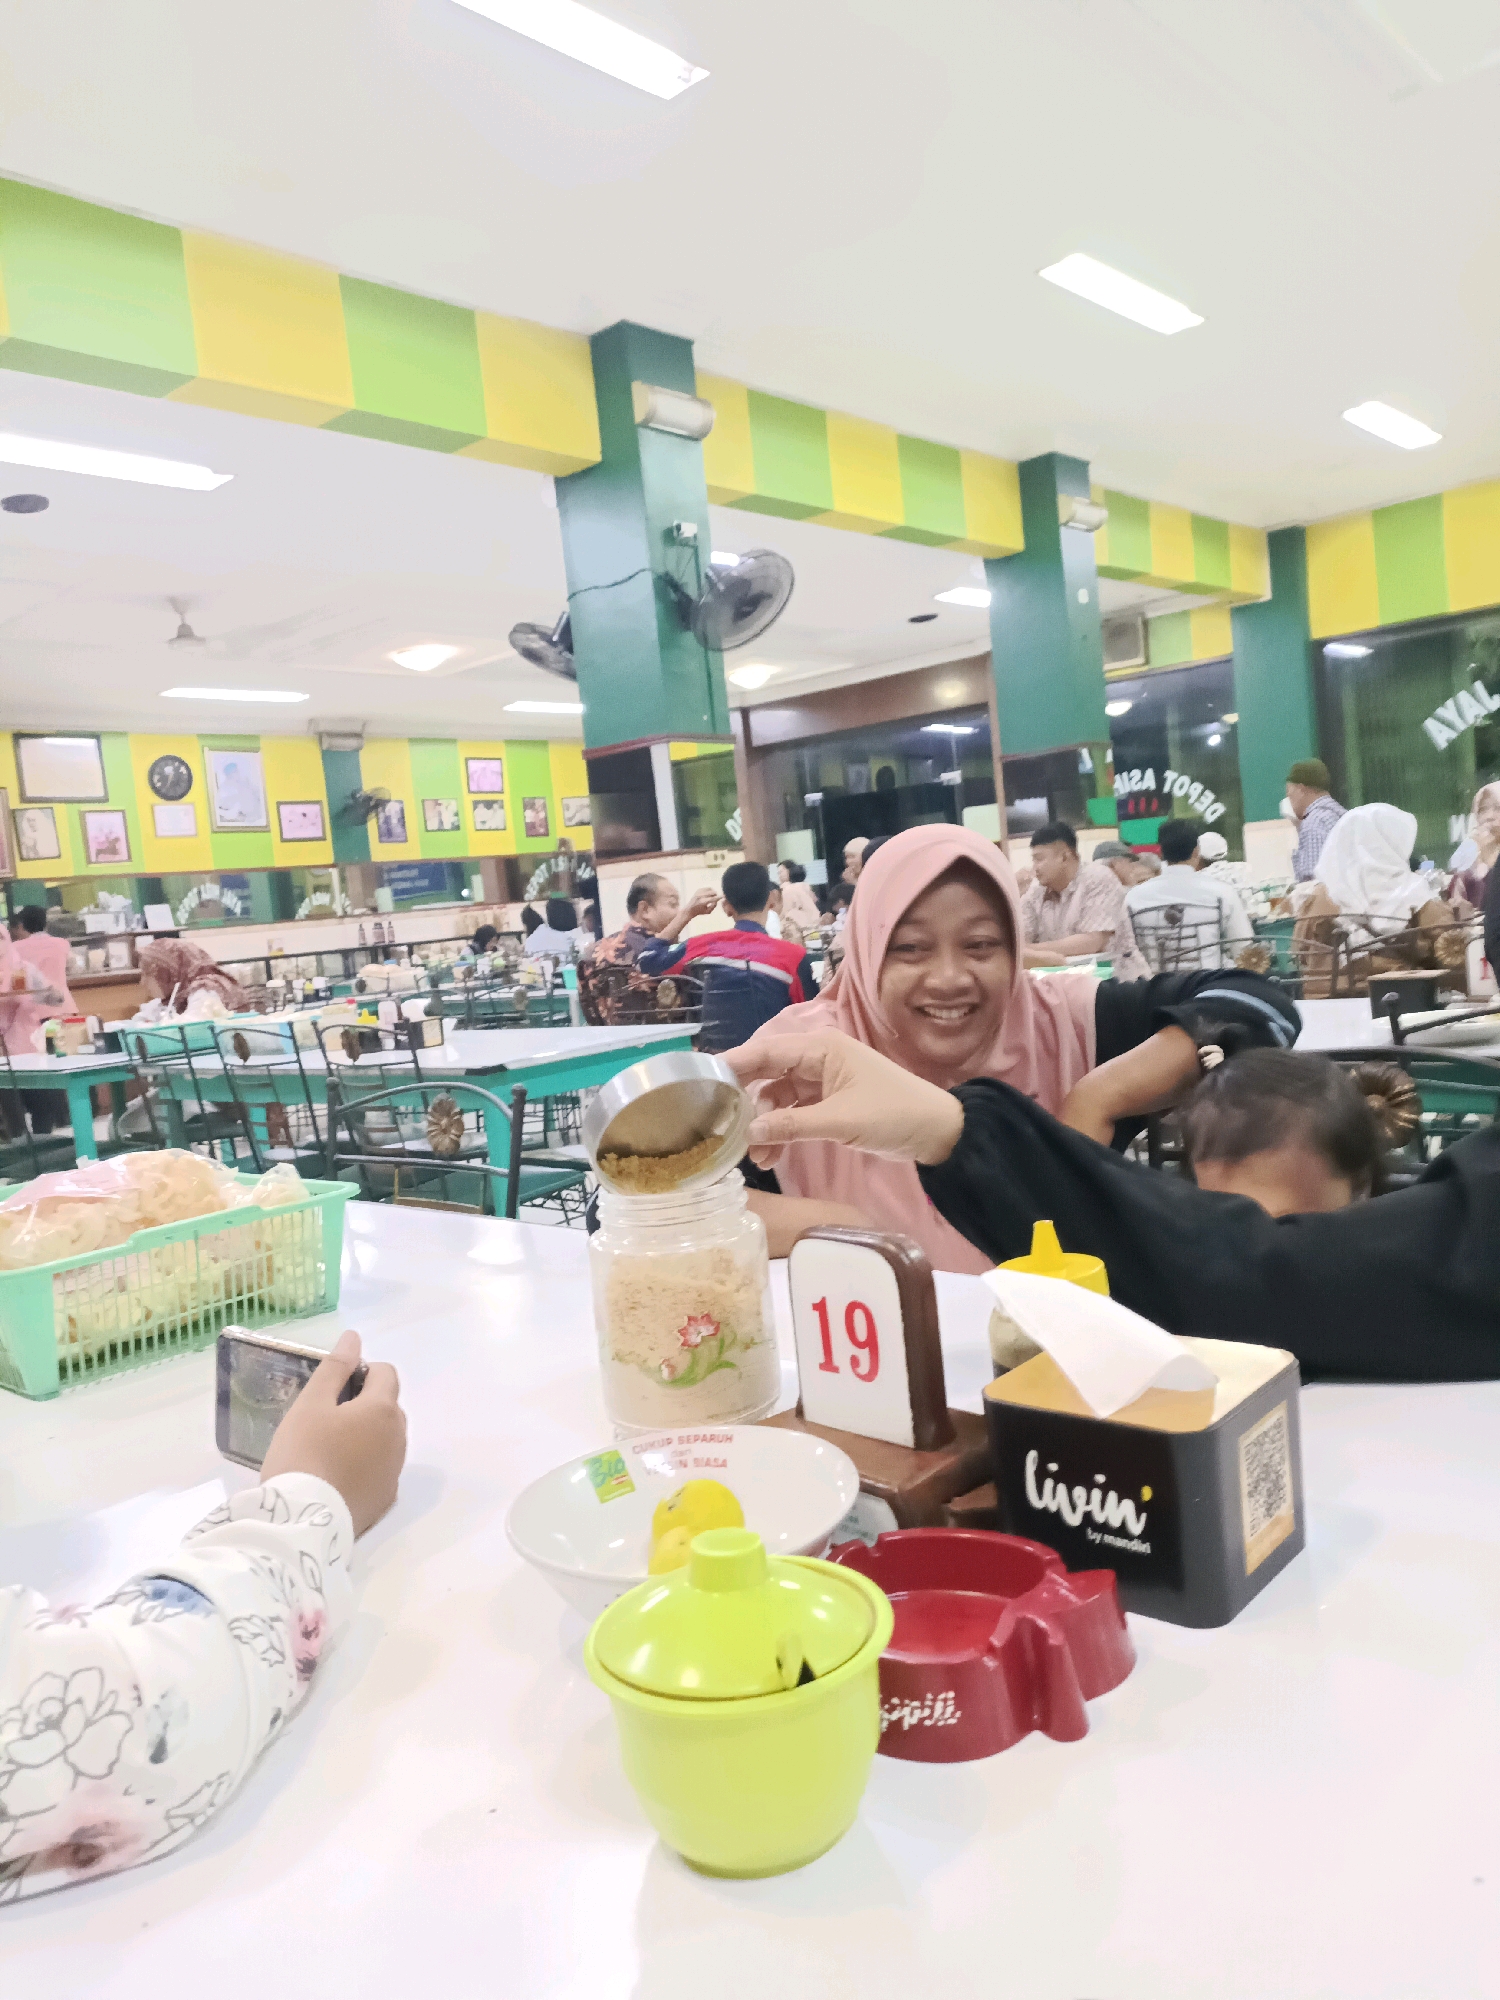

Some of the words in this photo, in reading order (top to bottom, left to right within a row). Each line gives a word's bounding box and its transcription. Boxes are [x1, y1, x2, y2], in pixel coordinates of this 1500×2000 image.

[812, 1296, 879, 1382] 19
[633, 1439, 672, 1454] CUKUP
[678, 1434, 734, 1445] SEPARUH
[694, 1458, 728, 1468] BIASA
[1086, 1526, 1102, 1544] by
